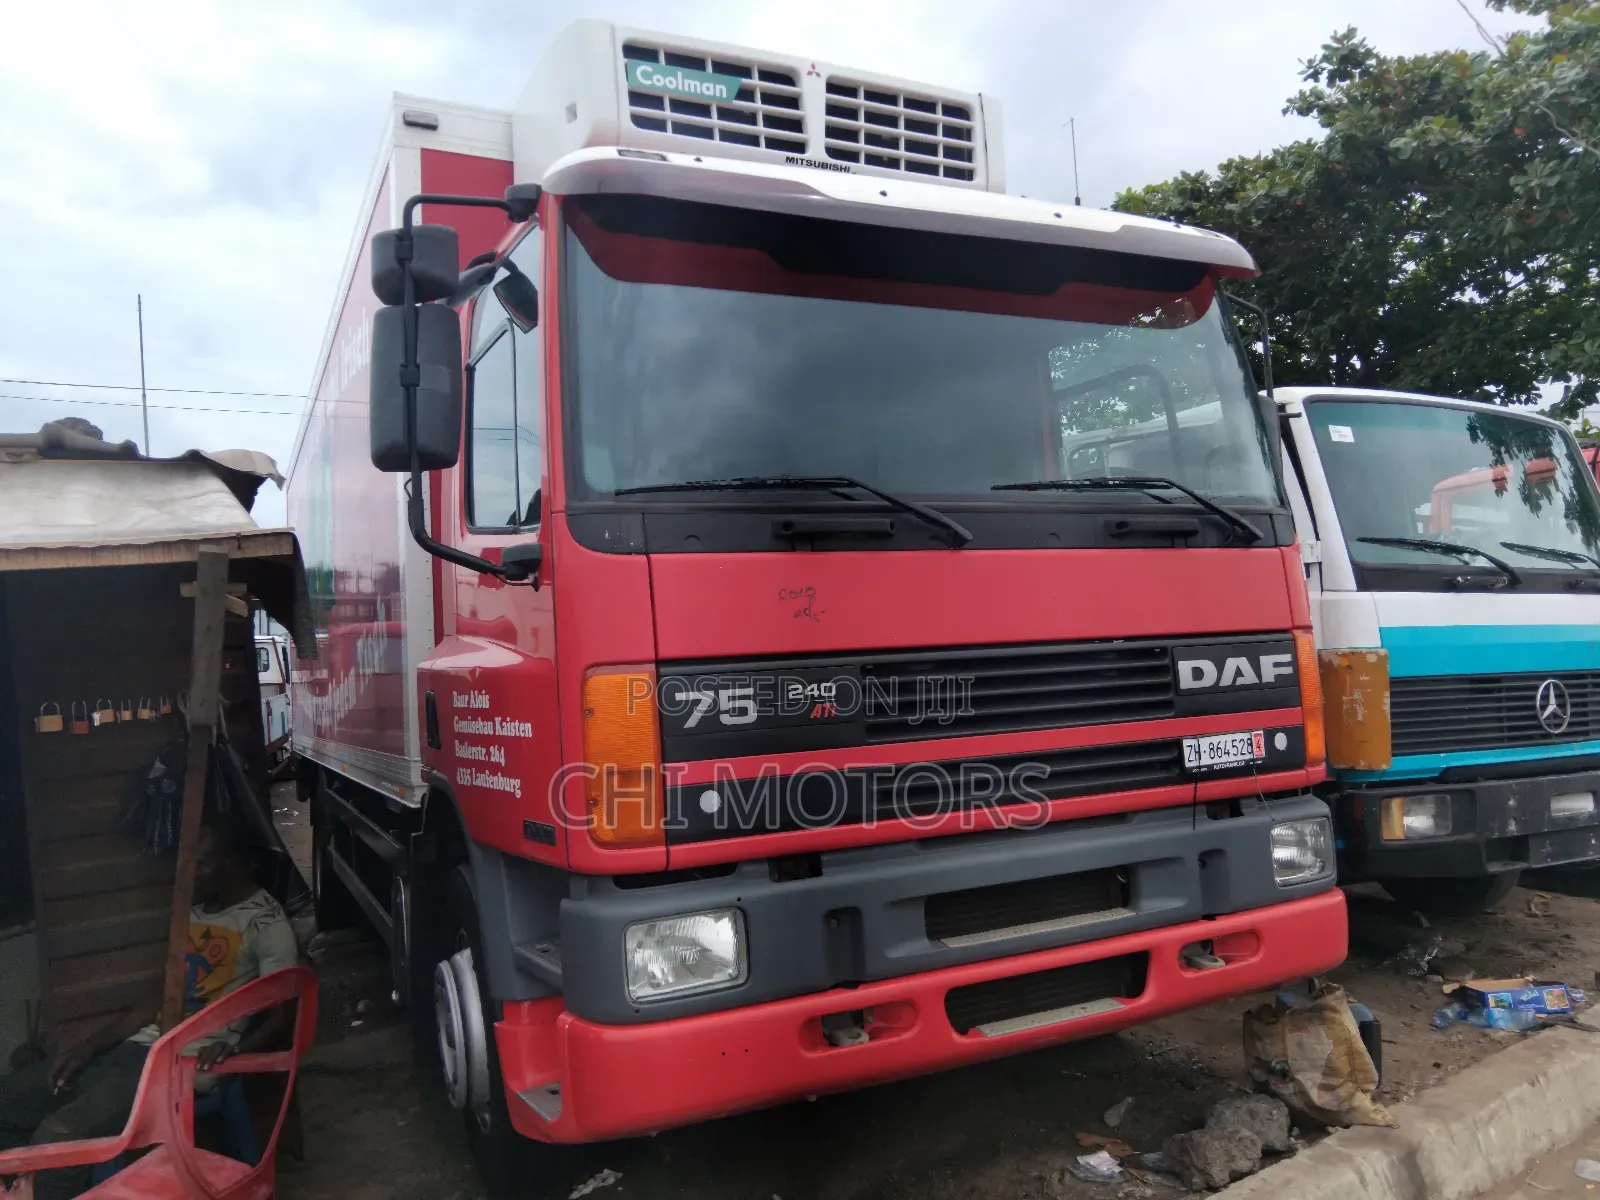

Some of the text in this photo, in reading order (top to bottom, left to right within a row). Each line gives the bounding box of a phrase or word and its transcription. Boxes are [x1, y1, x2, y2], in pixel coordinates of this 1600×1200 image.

[636, 65, 727, 98] Coolman
[785, 155, 850, 173] MITSUBISHI
[1178, 653, 1293, 689] DAF
[470, 690, 490, 709] Alois
[788, 682, 836, 699] 240
[675, 688, 758, 729] 75
[453, 716, 532, 737] Gemüsebau Kaisten
[472, 768, 521, 799] Laufenburg
